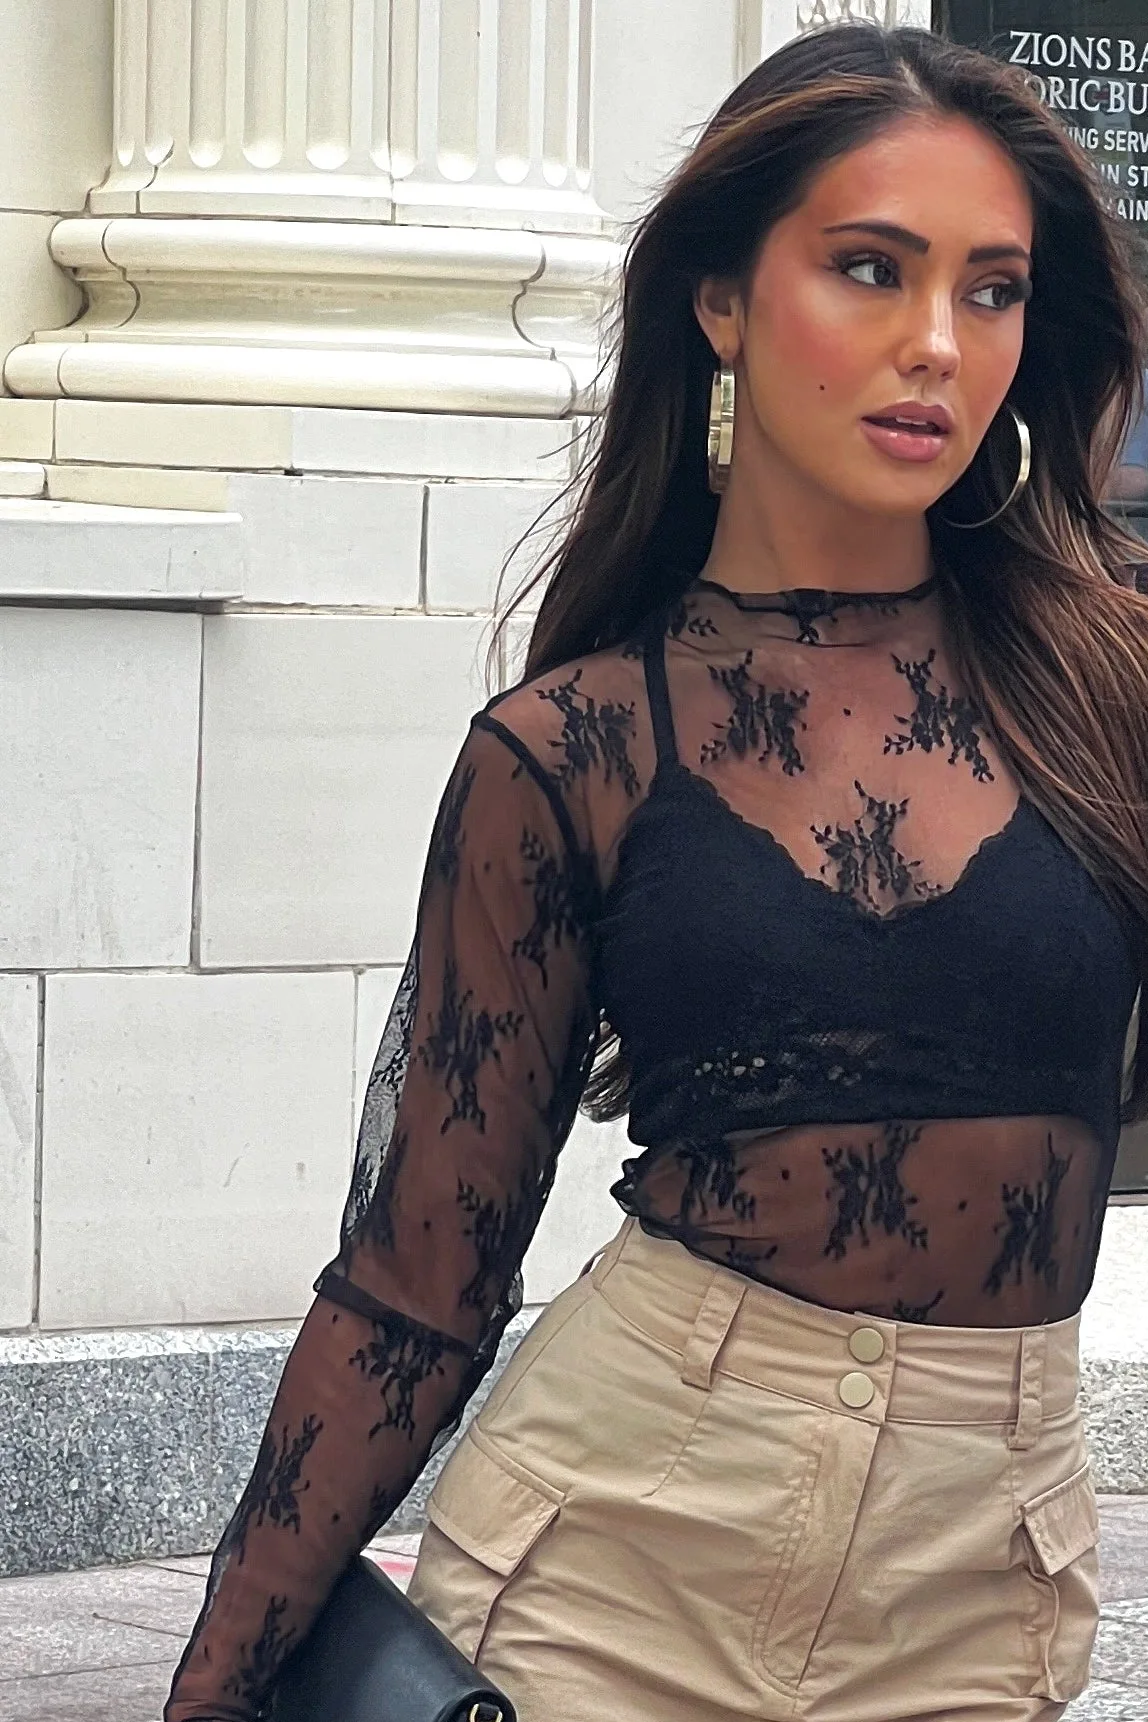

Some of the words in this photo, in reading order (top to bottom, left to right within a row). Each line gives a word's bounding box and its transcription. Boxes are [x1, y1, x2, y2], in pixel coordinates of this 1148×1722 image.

[1009, 30, 1111, 71] ZIONS
[1024, 75, 1100, 112] ORIC
[1117, 199, 1148, 221] AIN
